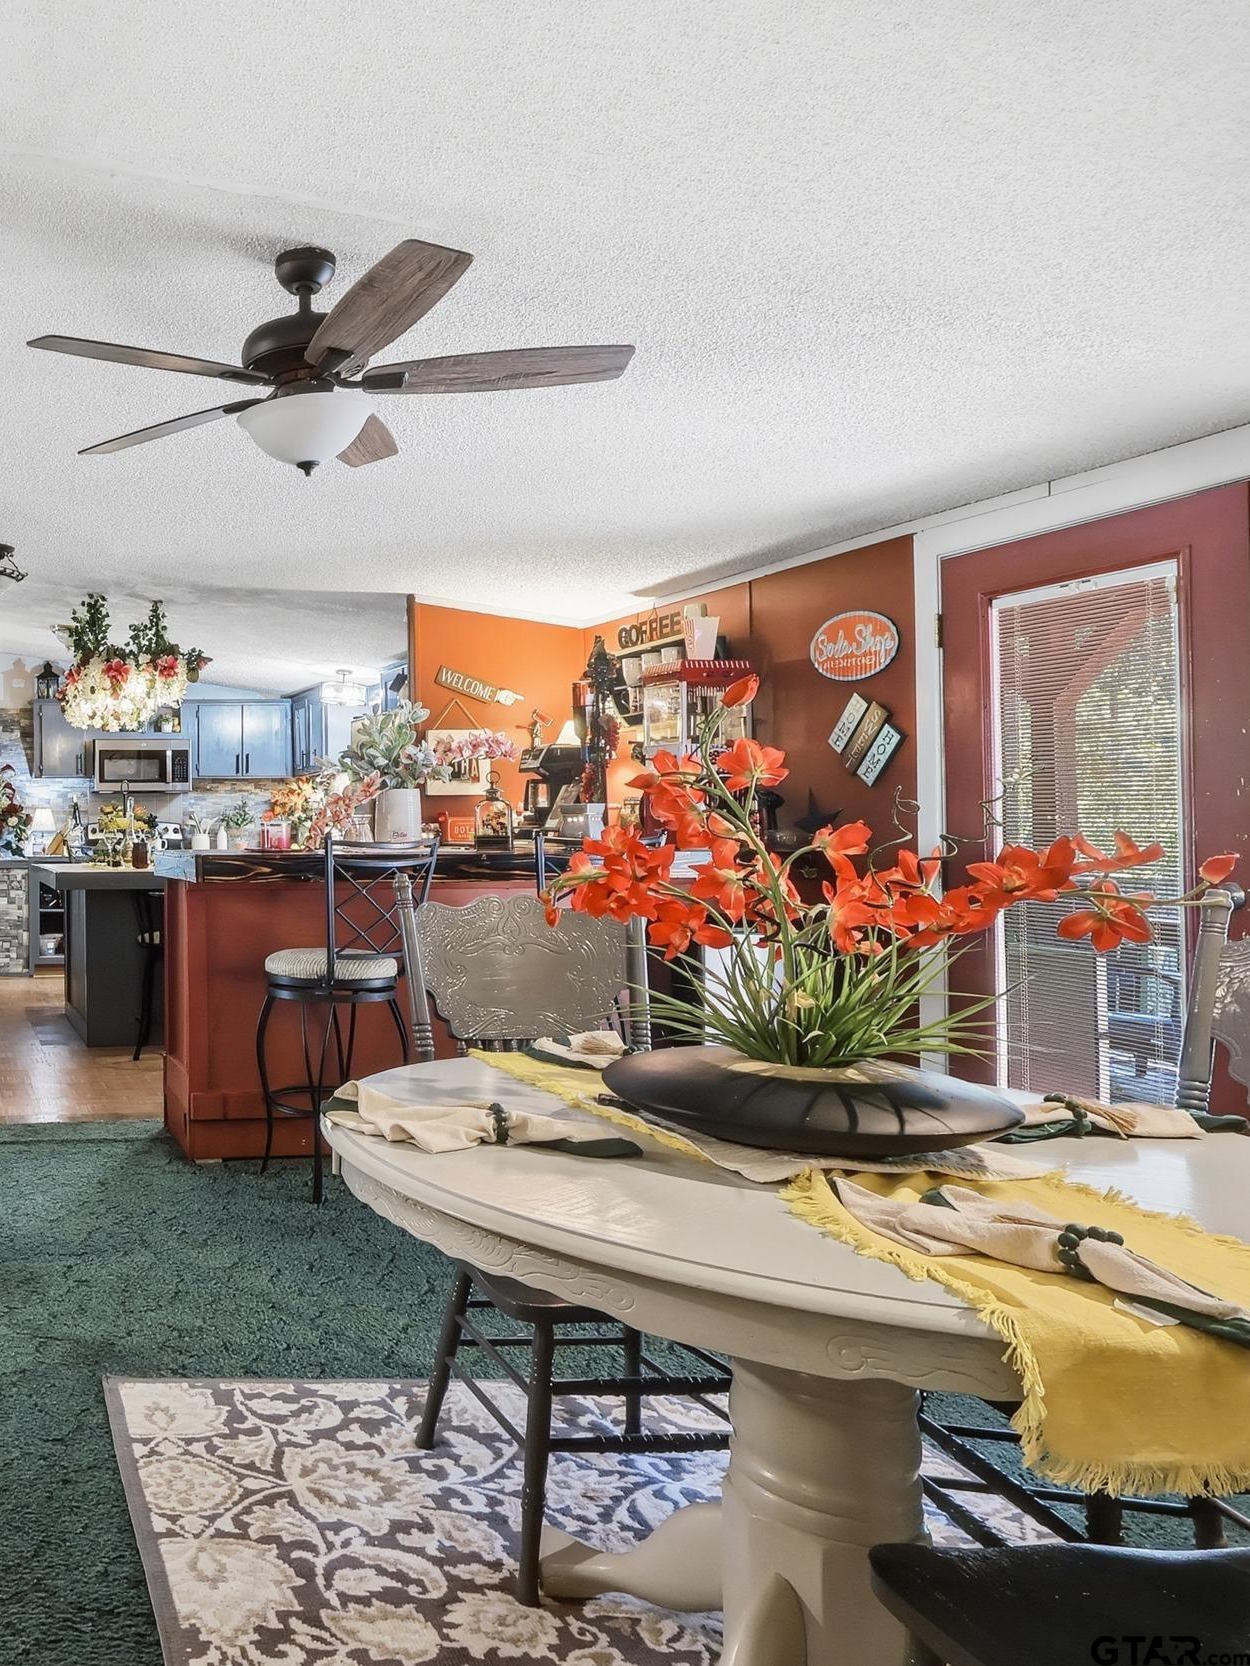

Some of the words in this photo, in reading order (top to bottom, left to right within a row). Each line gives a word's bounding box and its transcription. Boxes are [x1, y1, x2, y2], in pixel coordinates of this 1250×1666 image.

[618, 612, 681, 649] COFFEE
[816, 632, 851, 662] Soda
[852, 623, 895, 663] Shop
[441, 668, 495, 702] WELCOME
[833, 700, 864, 747] HOME
[846, 709, 881, 768] SWEET
[862, 730, 894, 779] HOME
